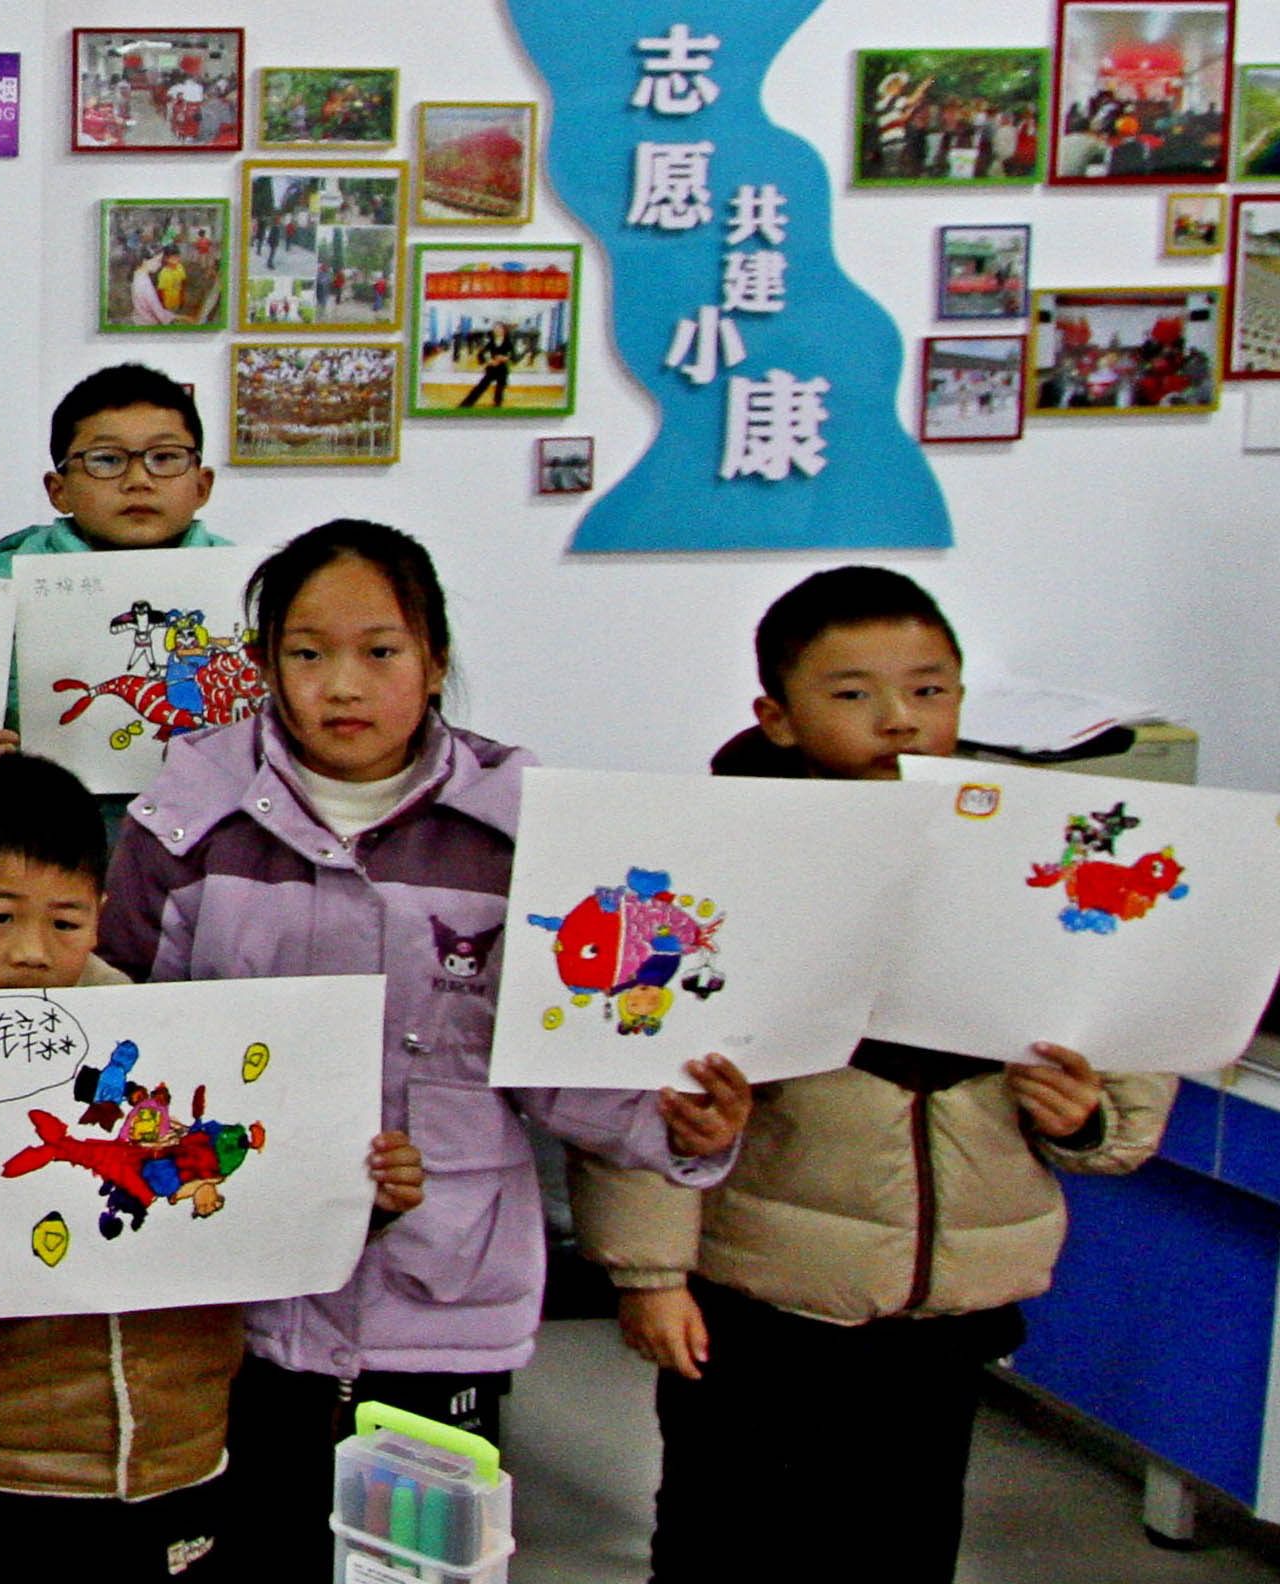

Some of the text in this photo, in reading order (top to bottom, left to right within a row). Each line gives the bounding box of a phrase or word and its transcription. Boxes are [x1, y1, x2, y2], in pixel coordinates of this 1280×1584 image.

[626, 24, 722, 231] 志愿
[720, 184, 790, 314] 共建
[664, 305, 830, 483] 小康
